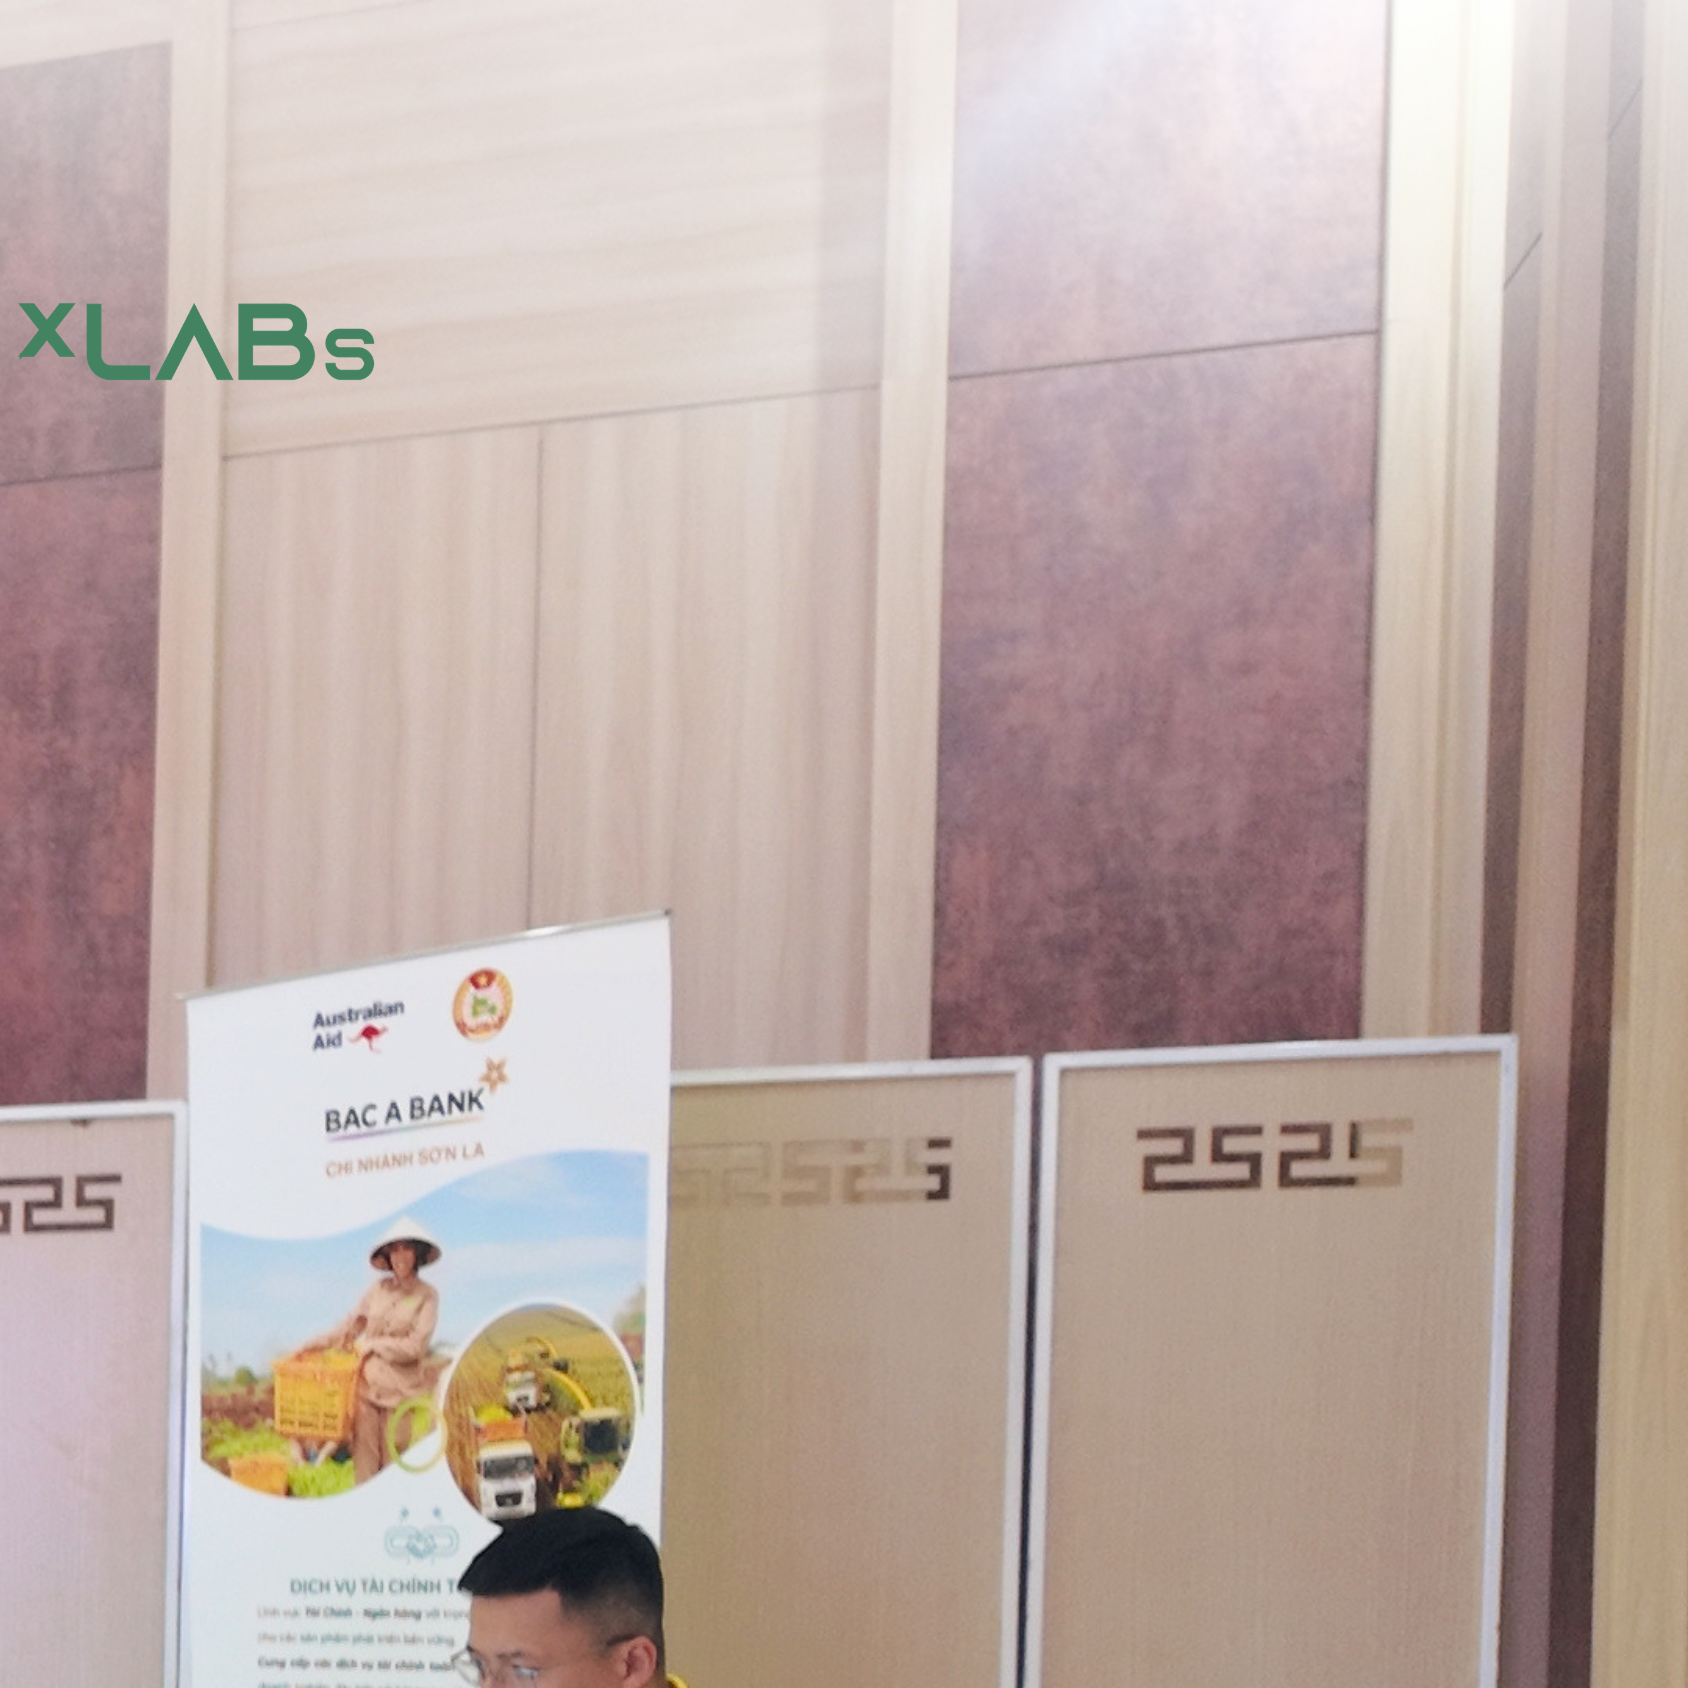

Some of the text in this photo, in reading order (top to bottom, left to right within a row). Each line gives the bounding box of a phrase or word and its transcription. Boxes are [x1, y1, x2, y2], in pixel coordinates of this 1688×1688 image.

[312, 1001, 405, 1031] Australian
[312, 1033, 343, 1051] Aid
[325, 1088, 485, 1134] BAC A BANK
[325, 1161, 353, 1178] CHI
[290, 1578, 330, 1597] DỊCH
[335, 1578, 356, 1597] VỤ
[361, 1576, 384, 1594] TÀI
[389, 1576, 440, 1594] CHÍNH
